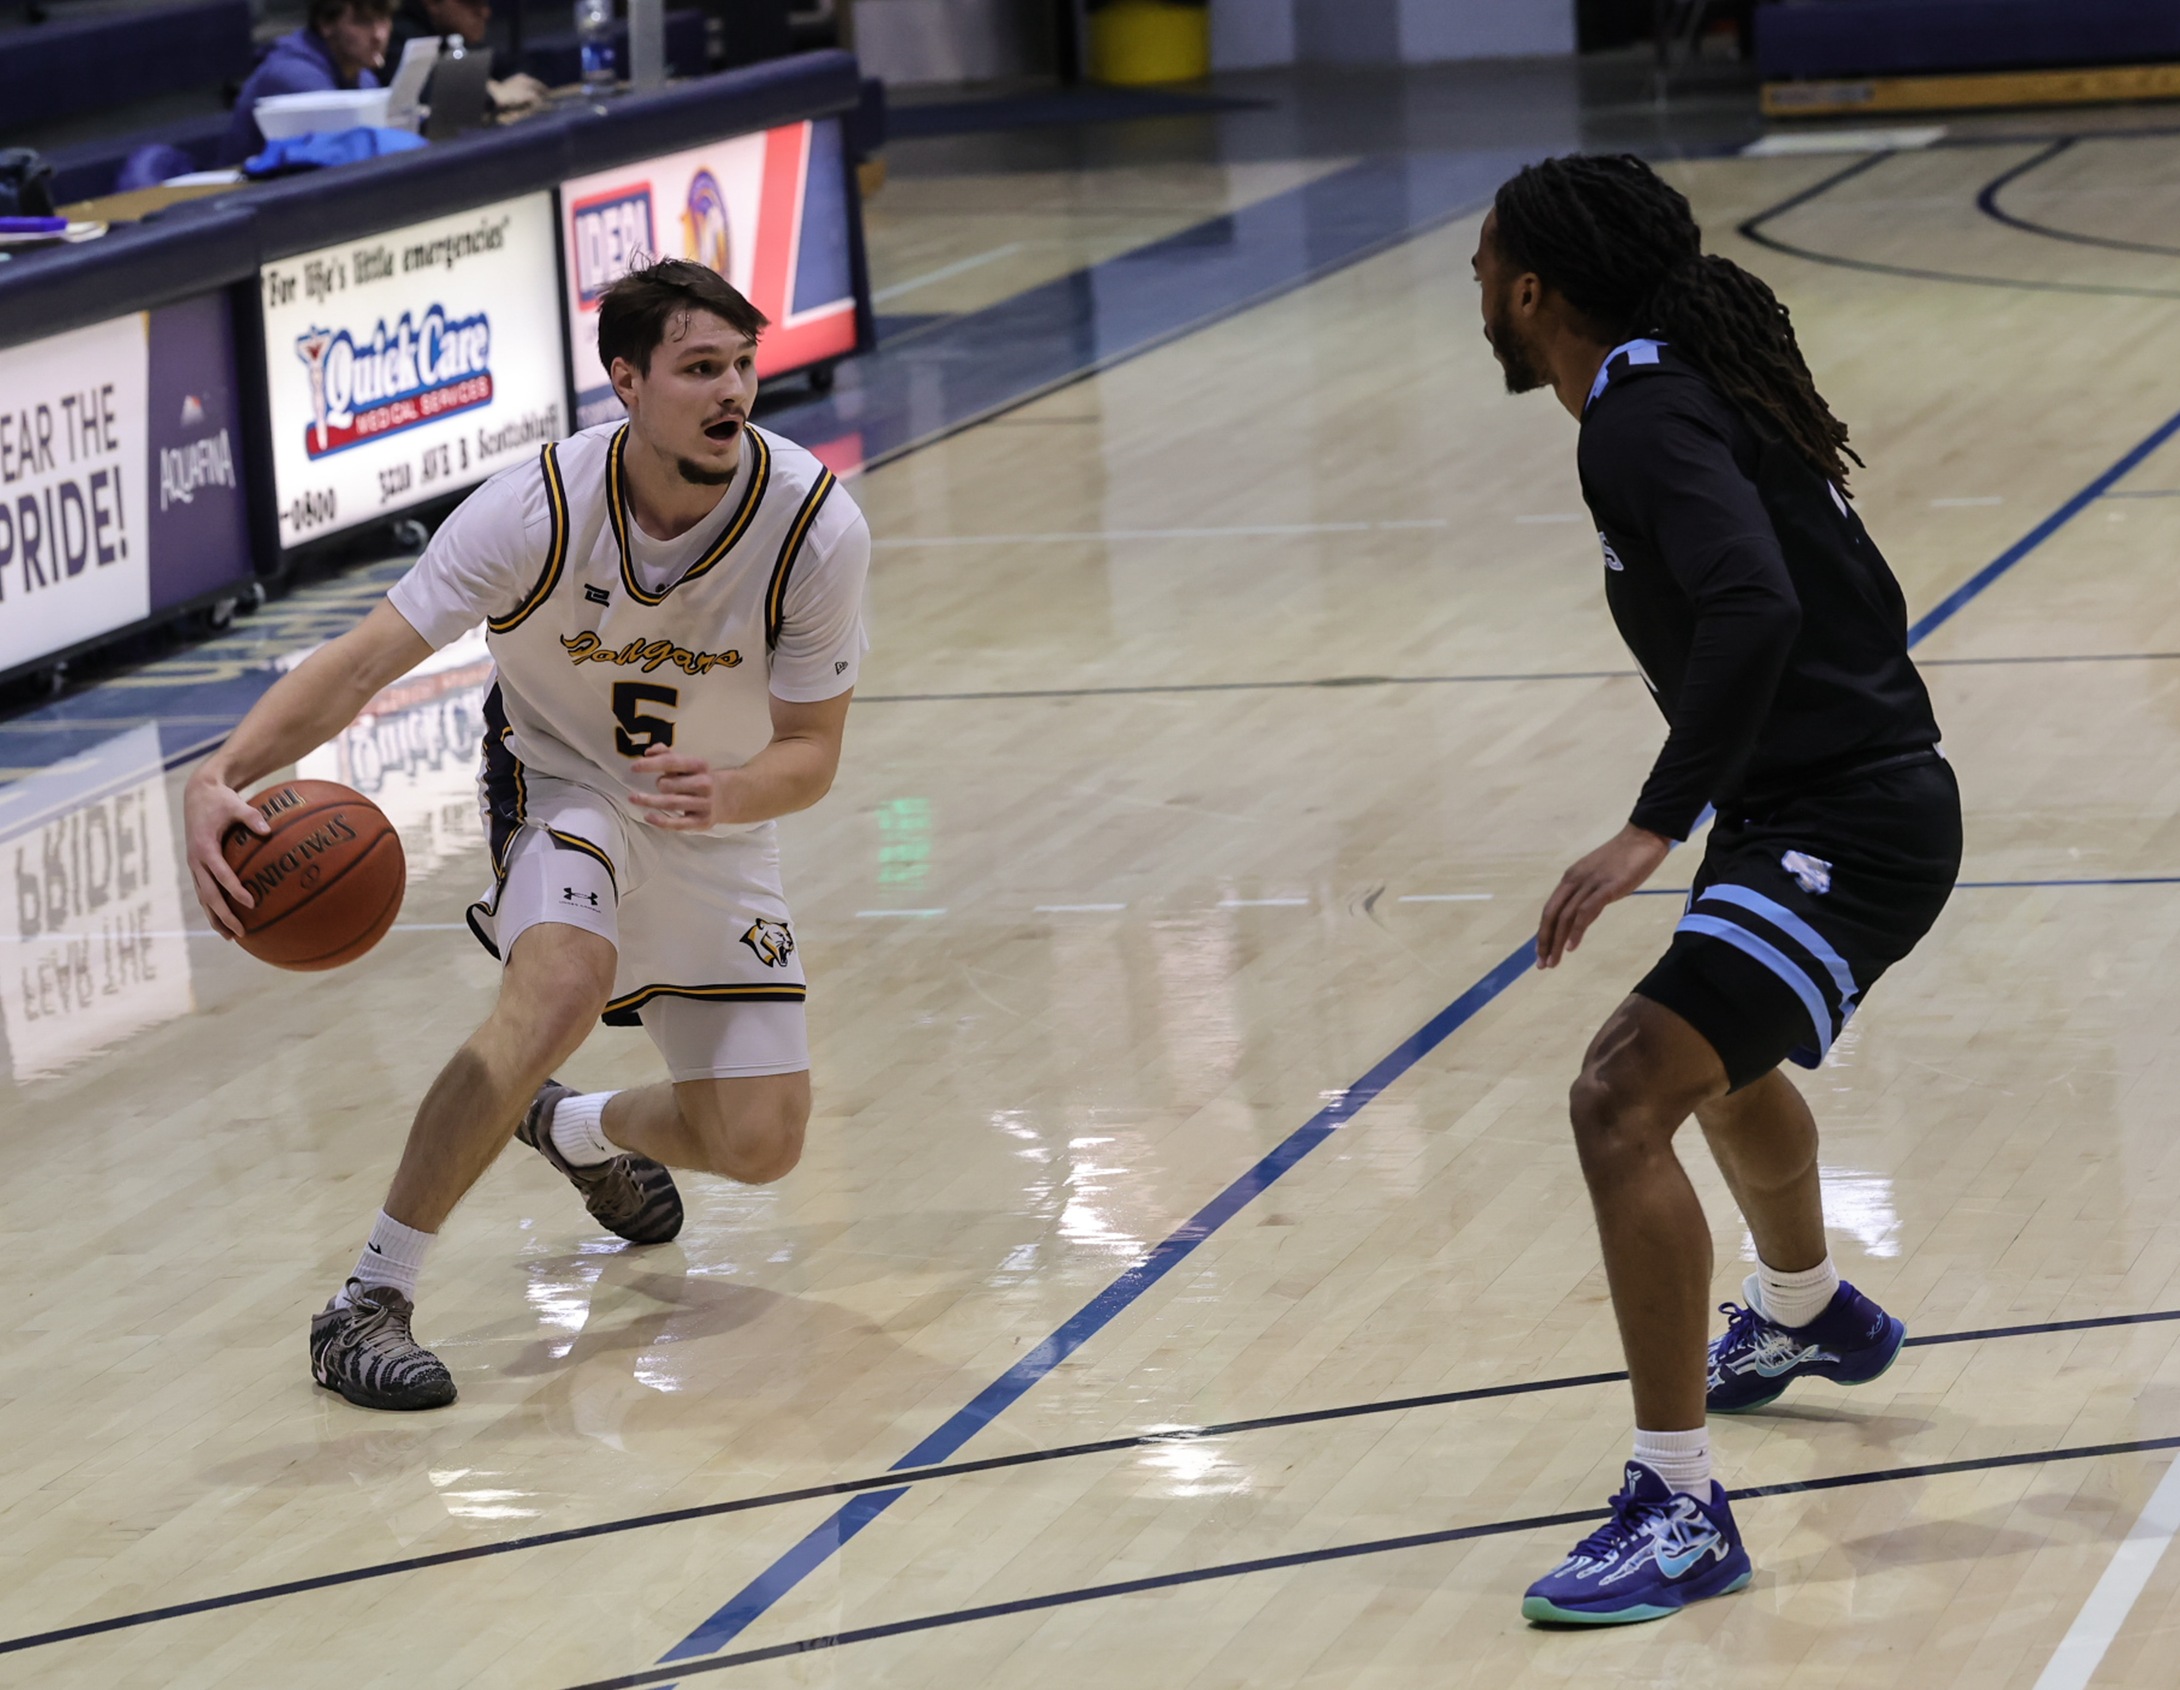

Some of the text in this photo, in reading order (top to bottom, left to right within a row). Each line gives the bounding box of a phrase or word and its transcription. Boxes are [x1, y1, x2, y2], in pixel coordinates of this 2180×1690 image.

[0, 384, 118, 483] EAR THE
[160, 428, 236, 511] AQUAFINA
[0, 464, 128, 603] PRIDE!
[612, 680, 681, 759] 5
